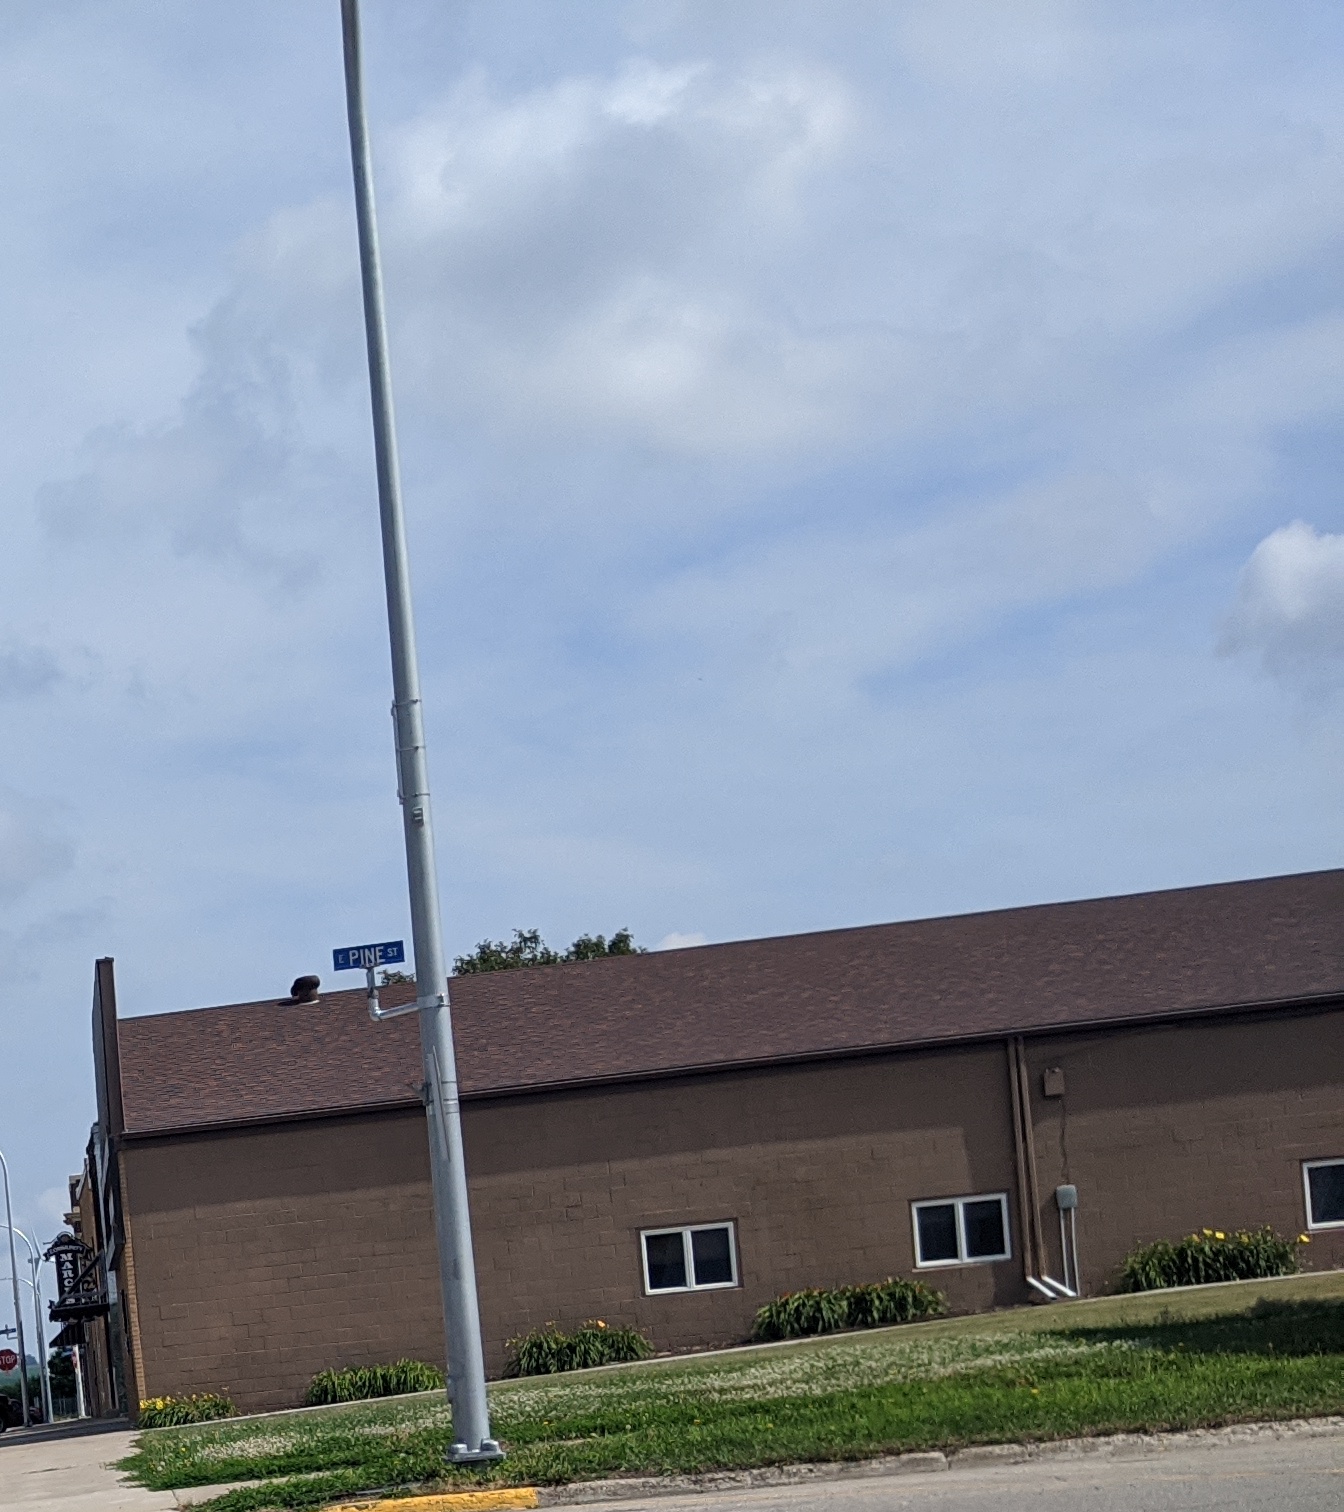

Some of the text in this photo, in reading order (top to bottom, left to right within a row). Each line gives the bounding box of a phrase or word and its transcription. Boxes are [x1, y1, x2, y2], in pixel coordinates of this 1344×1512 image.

[338, 945, 398, 967] E PINE ST
